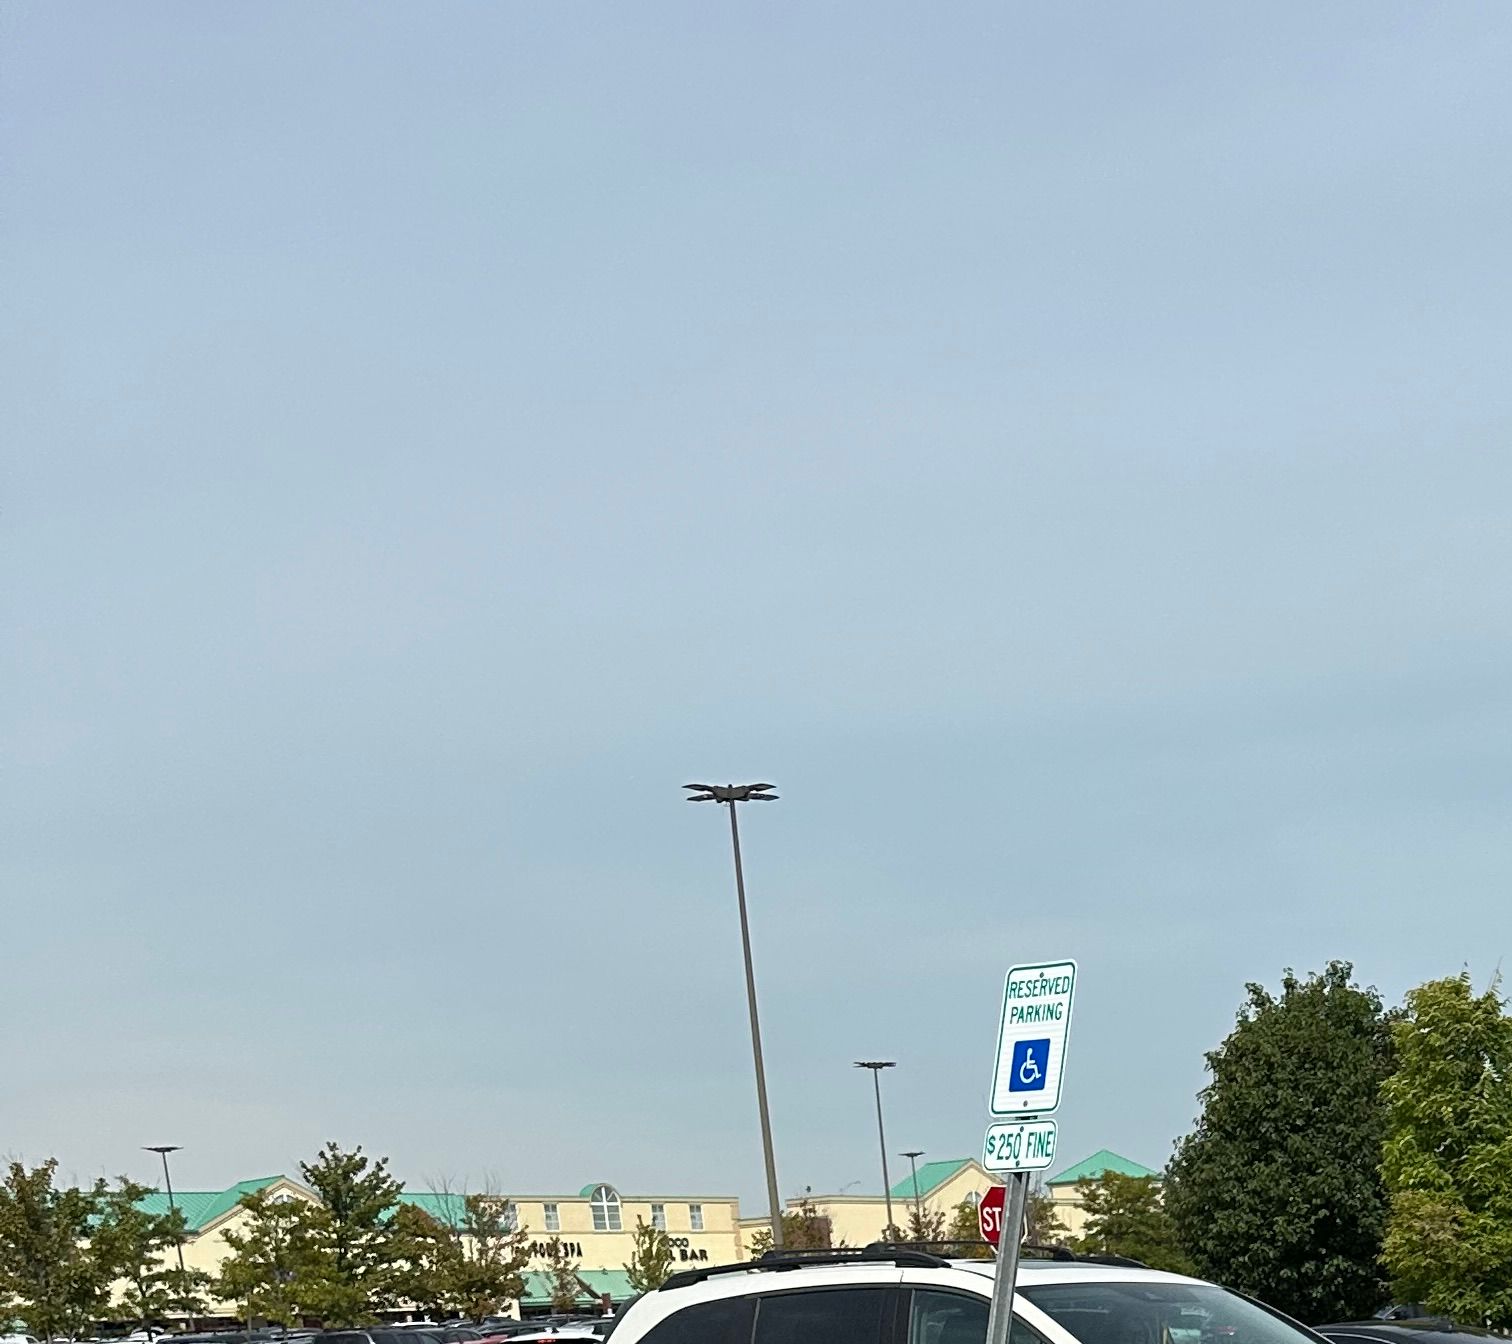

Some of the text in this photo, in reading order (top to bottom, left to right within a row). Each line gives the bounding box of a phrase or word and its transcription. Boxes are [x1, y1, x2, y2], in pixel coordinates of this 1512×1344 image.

[1009, 976, 1070, 999] RESERVED
[1010, 1002, 1063, 1024] PARKING
[1026, 1131, 1053, 1158] FINE
[983, 1207, 1001, 1232] ST
[563, 1242, 583, 1258] SPA
[680, 1249, 708, 1261] BAR
